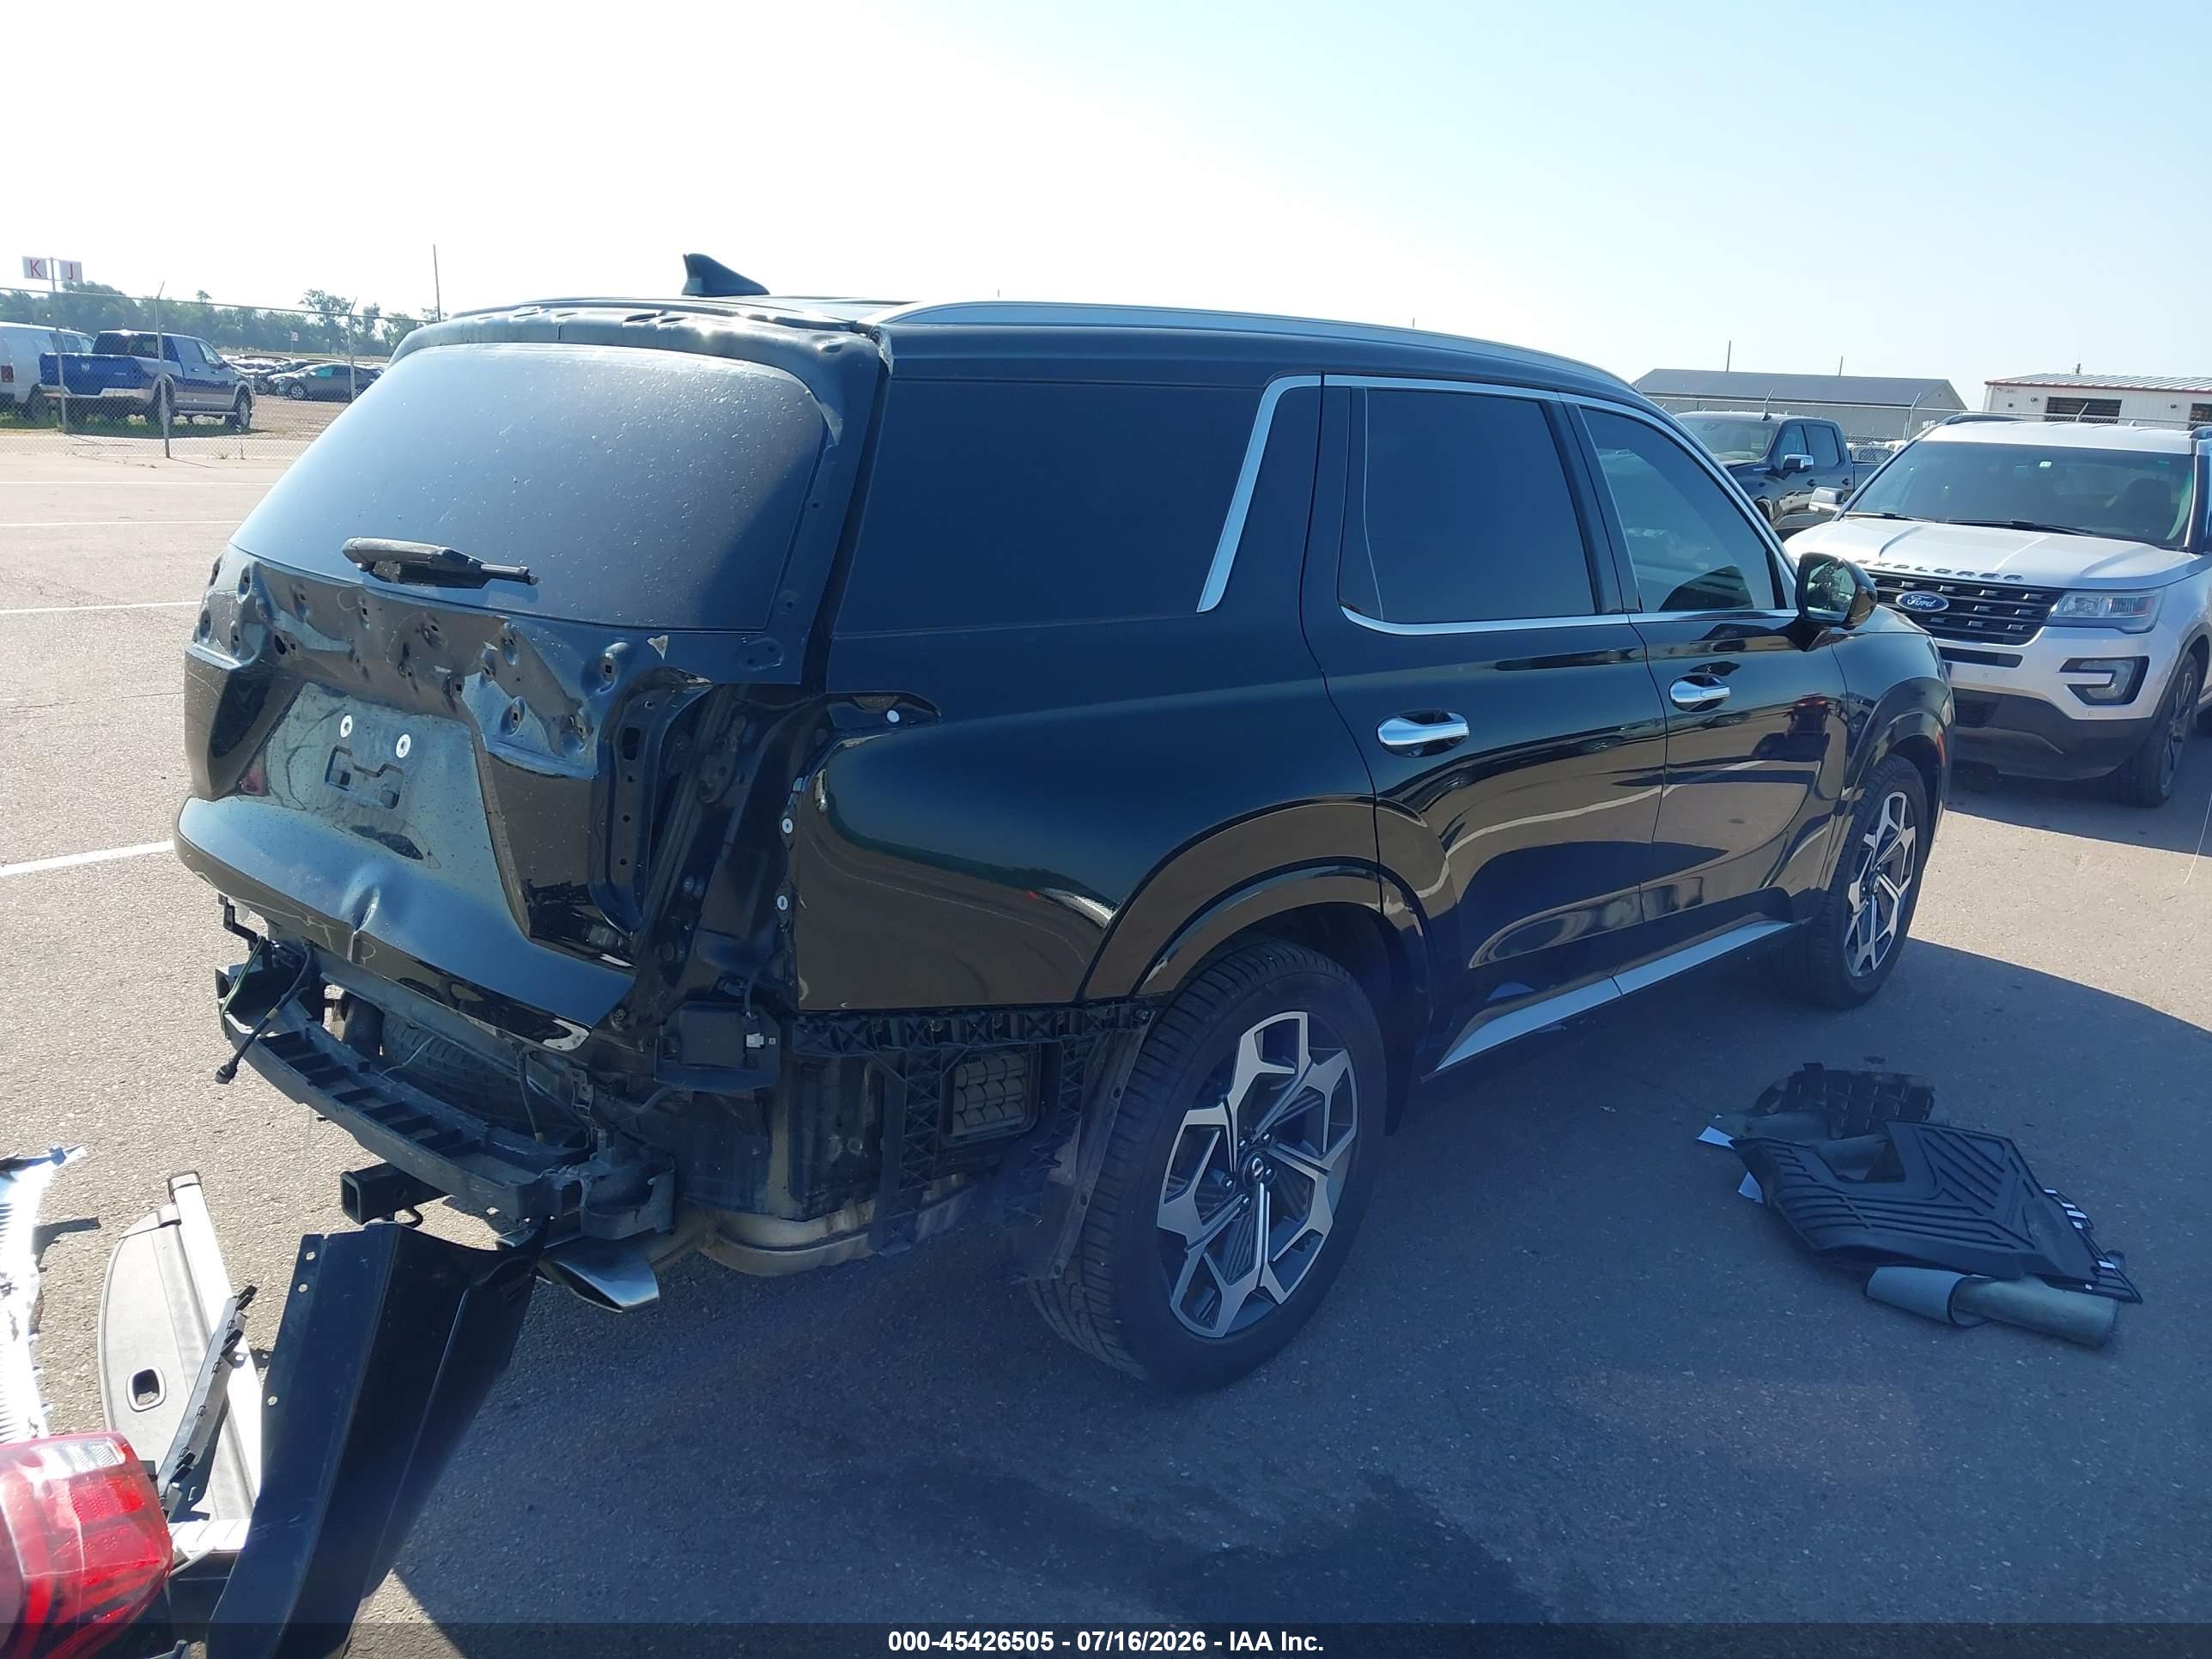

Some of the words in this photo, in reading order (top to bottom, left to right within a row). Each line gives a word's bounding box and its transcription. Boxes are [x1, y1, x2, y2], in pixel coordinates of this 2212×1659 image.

[29, 258, 42, 277] K
[68, 262, 74, 280] J
[1906, 594, 1936, 608] Ford
